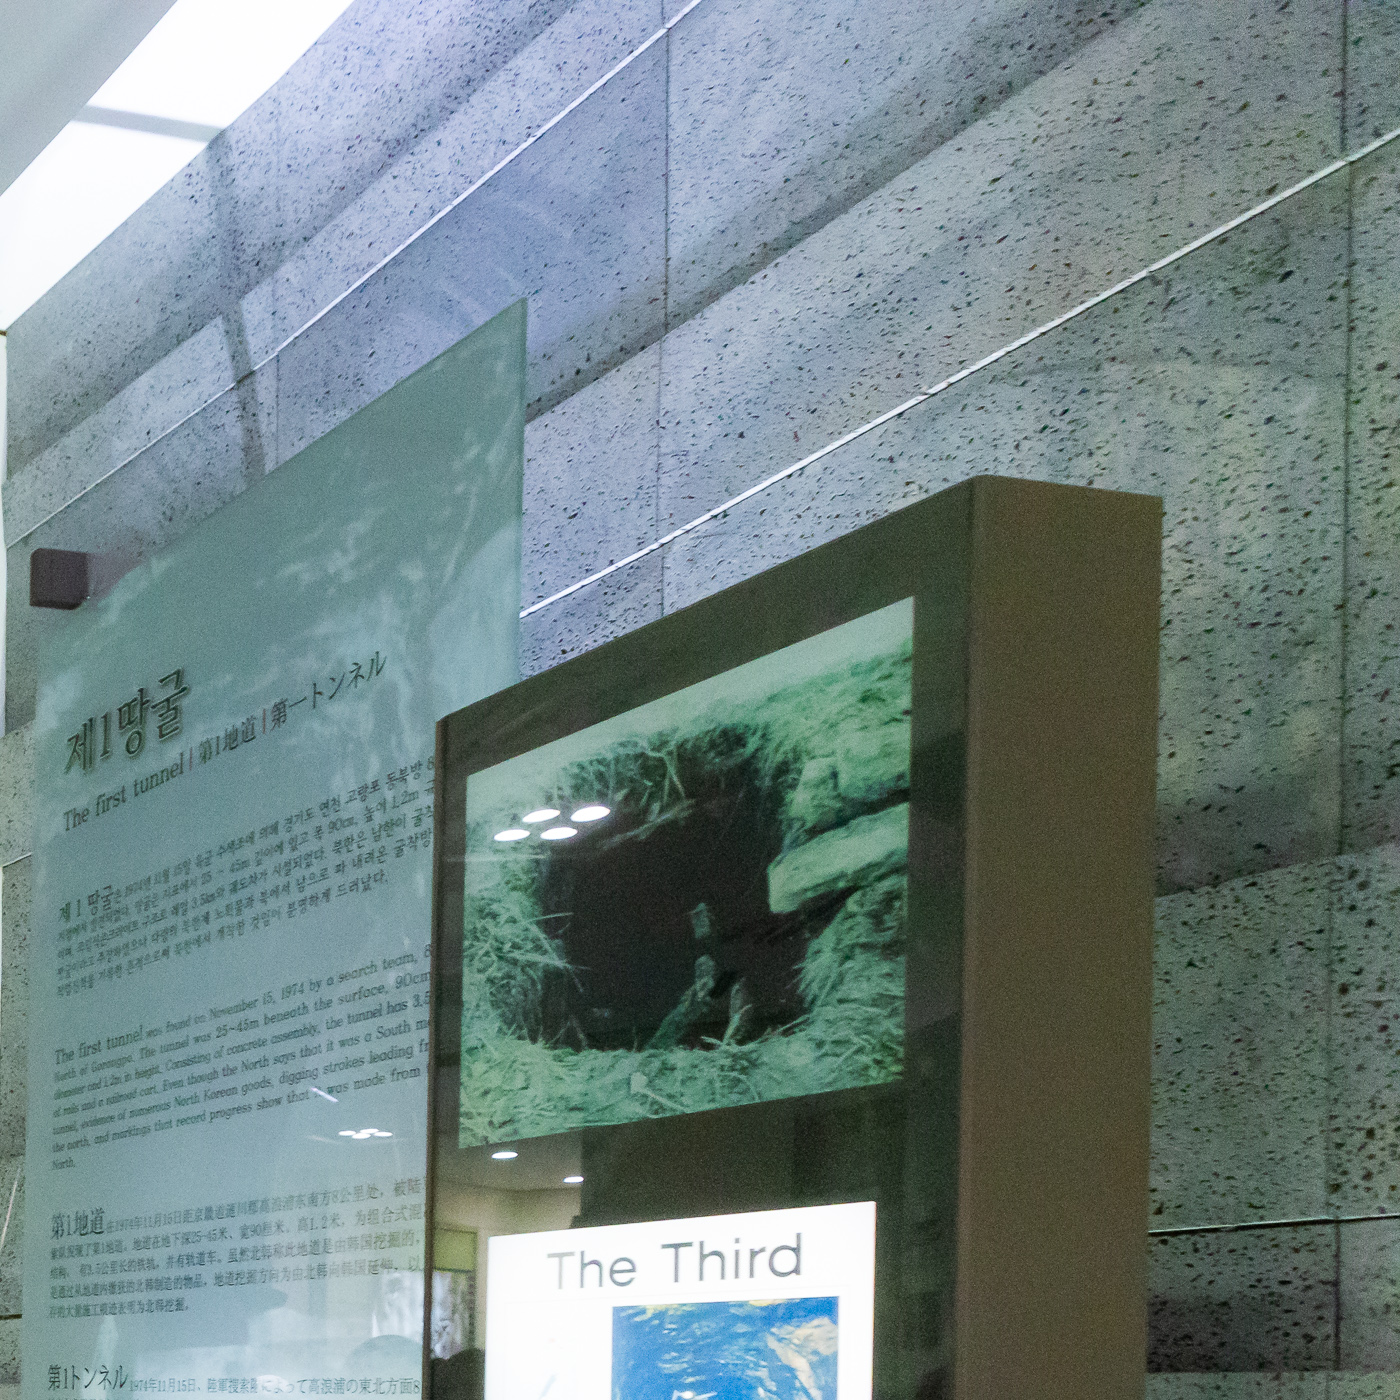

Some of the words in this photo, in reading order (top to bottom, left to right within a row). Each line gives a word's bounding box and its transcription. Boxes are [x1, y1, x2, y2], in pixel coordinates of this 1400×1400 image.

[64, 667, 190, 775] 제1땅굴
[269, 649, 387, 731] 第一トンネル
[197, 714, 257, 765] 第1地道
[63, 806, 89, 832] The
[94, 783, 127, 818] first
[132, 752, 184, 798] tunnel
[287, 830, 309, 853] 있고
[363, 797, 386, 823] 높이
[58, 900, 71, 922] 제
[283, 806, 314, 833] 경기도
[318, 794, 341, 818] 연천
[344, 777, 381, 805] 고랑포
[385, 759, 423, 788] 동북방
[271, 845, 327, 877] 시설되었다.
[331, 830, 367, 854] 북한은
[371, 815, 406, 843] 남한이
[295, 866, 330, 893] 남으로
[351, 844, 388, 869] 내려온
[285, 886, 331, 919] 분명하게
[334, 867, 389, 897] 드러났다.
[54, 1046, 74, 1066] The
[78, 1038, 102, 1059] first
[106, 1023, 143, 1050] tunnel
[209, 997, 258, 1019] November
[280, 980, 305, 1000] 1974
[308, 977, 322, 993] by
[337, 959, 378, 984] search
[381, 952, 418, 971] team,
[139, 1045, 156, 1060] The
[159, 1034, 189, 1054] tunnel
[192, 1032, 211, 1044] was
[263, 1000, 309, 1026] beneath
[313, 996, 333, 1012] the
[337, 983, 389, 1005] surface,
[213, 1044, 224, 1059] of
[226, 1037, 267, 1056] concrete
[324, 1015, 343, 1031] the
[346, 1002, 383, 1025] tunnel
[385, 1000, 408, 1015] has
[128, 1100, 171, 1118] numerous
[174, 1091, 200, 1107] North
[202, 1085, 238, 1102] Korean
[278, 1066, 319, 1086] digging
[322, 1055, 365, 1075] strokes
[368, 1045, 414, 1064] leading
[161, 1078, 184, 1092] Even
[186, 1067, 219, 1086] though
[221, 1063, 238, 1078] the
[240, 1053, 270, 1071] North
[273, 1051, 296, 1065] says
[299, 1042, 322, 1059] that
[337, 1035, 360, 1048] was
[375, 1018, 411, 1040] South
[93, 1130, 109, 1145] and
[111, 1124, 151, 1141] markings
[153, 1118, 172, 1132] that
[175, 1109, 206, 1128] record
[208, 1102, 253, 1124] progress
[255, 1095, 283, 1111] show
[286, 1089, 310, 1105] that
[326, 1081, 349, 1095] was
[352, 1071, 386, 1091] made
[390, 1066, 421, 1082] from
[547, 1250, 637, 1290] The
[660, 1232, 802, 1284] Third
[47, 1363, 129, 1390] 第1トンネル
